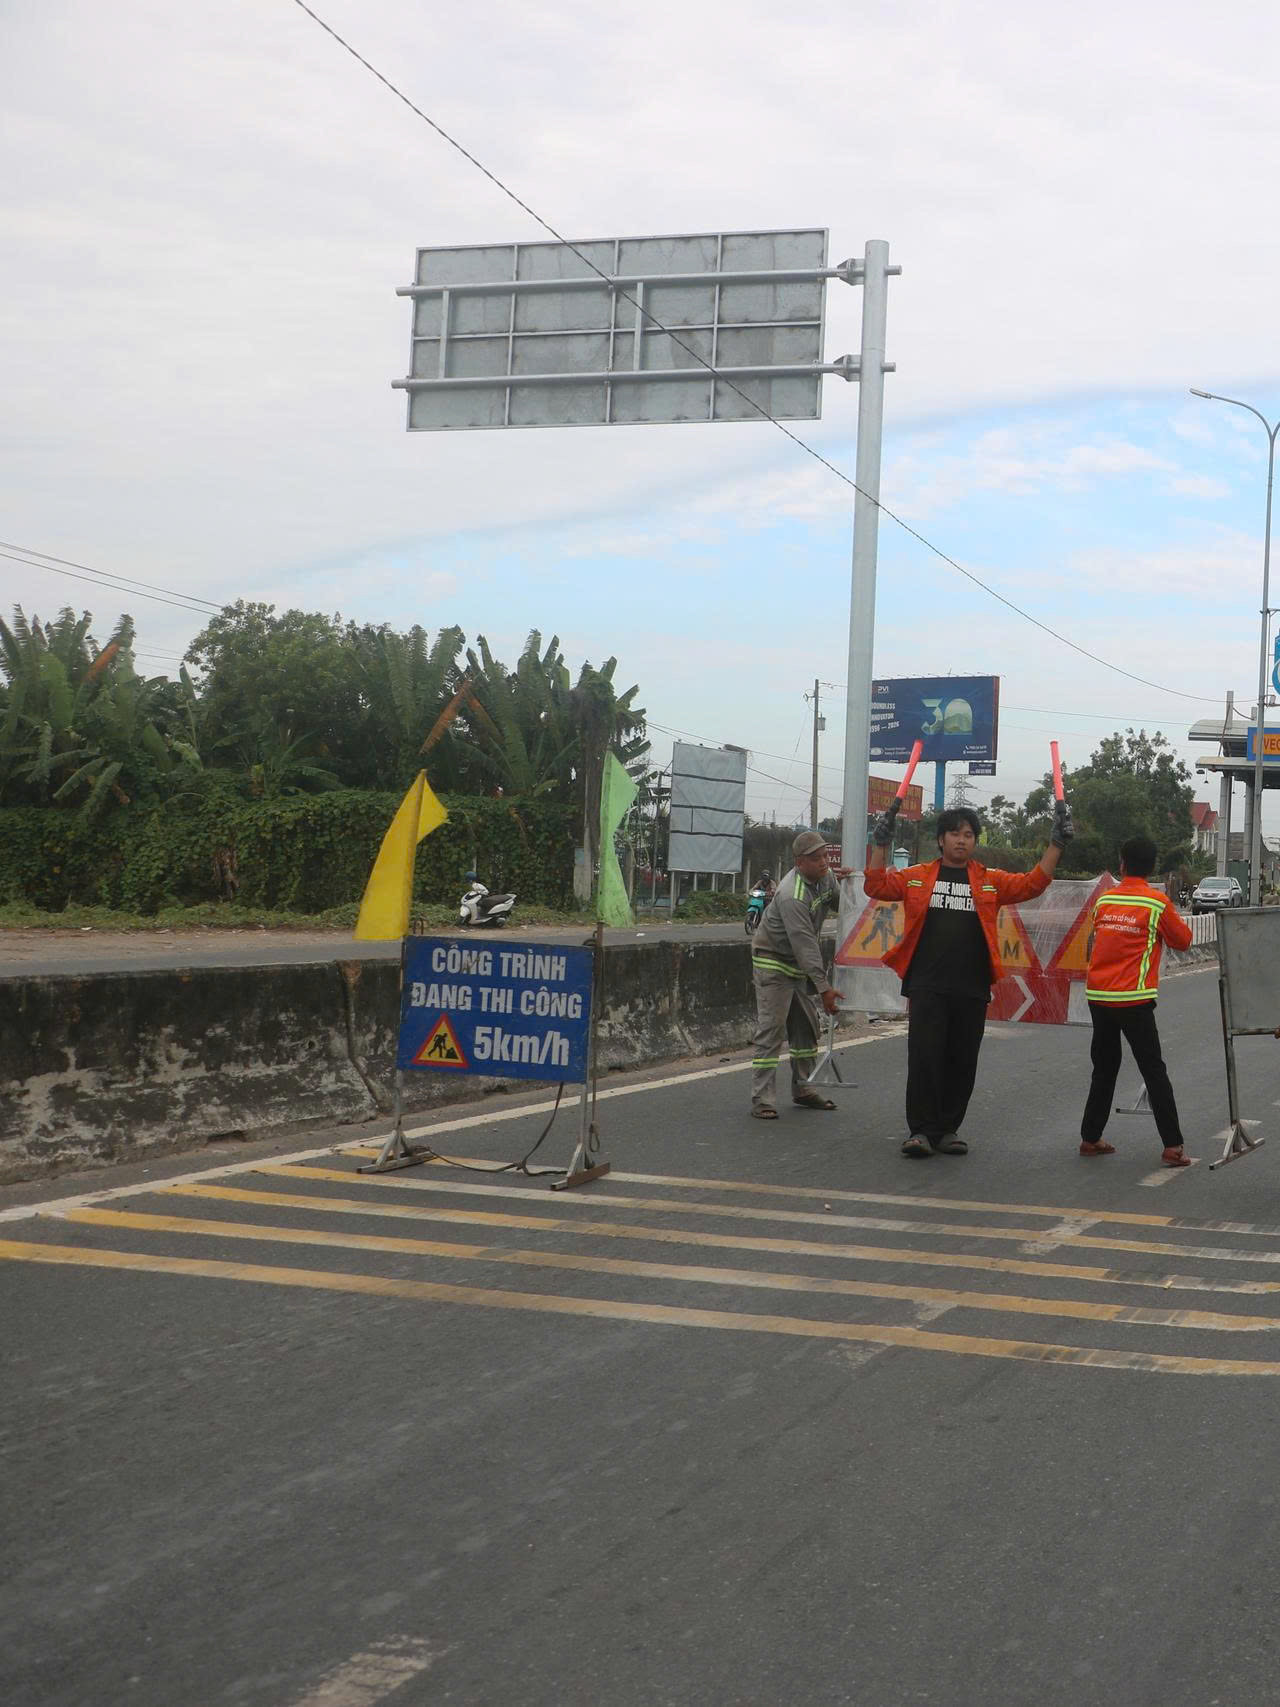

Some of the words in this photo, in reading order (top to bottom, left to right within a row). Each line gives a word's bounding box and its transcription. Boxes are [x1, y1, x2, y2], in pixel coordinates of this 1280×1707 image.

[951, 882, 972, 896] MONE
[432, 944, 493, 976] CÔNG
[500, 949, 566, 981] TRÌNH
[411, 982, 472, 1010] ĐANG
[480, 987, 514, 1014] THI
[520, 986, 582, 1019] CÔNG
[474, 1026, 570, 1066] 5km/h
